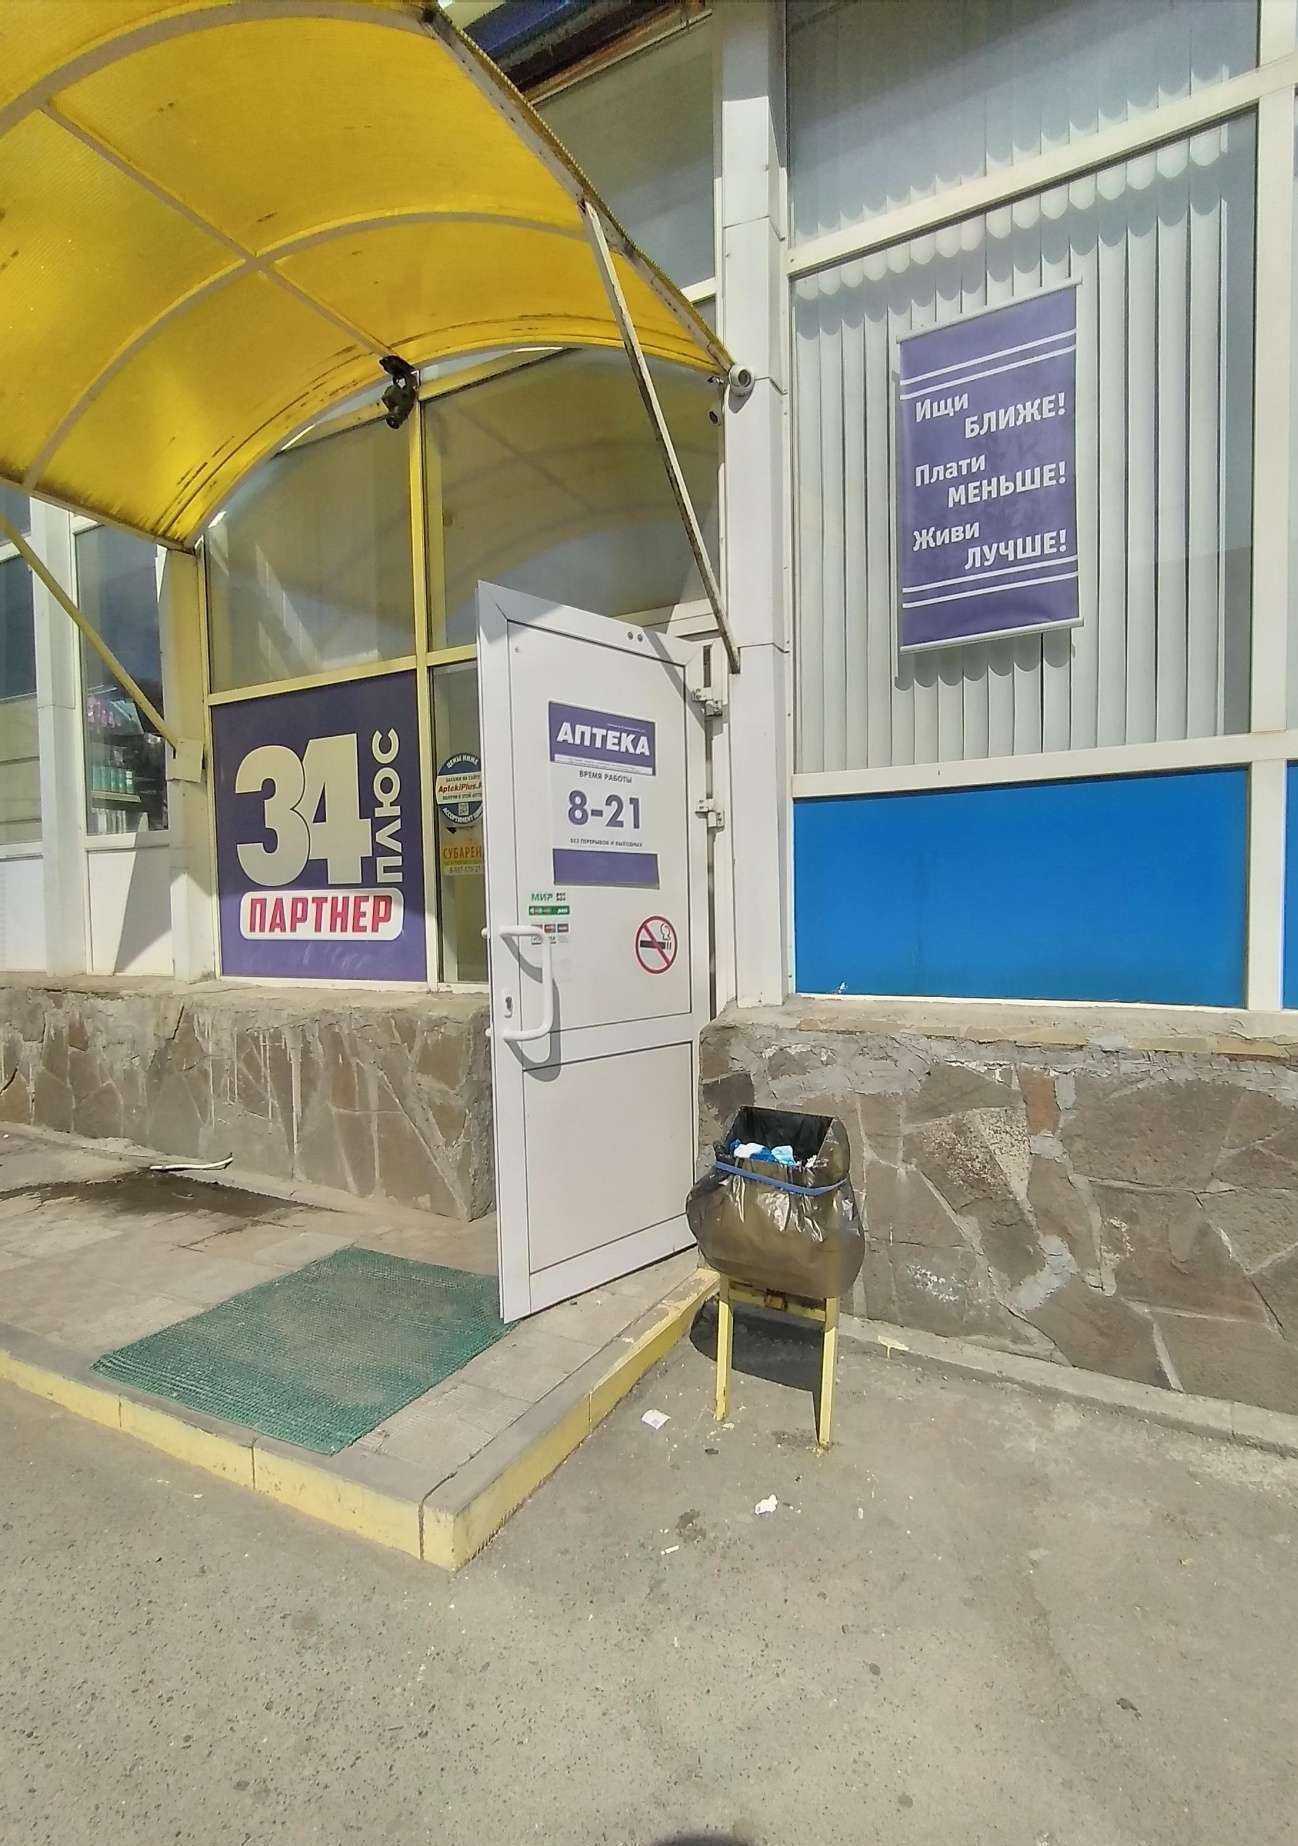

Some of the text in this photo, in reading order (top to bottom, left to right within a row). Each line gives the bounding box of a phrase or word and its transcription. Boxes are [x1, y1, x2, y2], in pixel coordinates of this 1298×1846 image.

[915, 393, 969, 422] Ищи
[965, 392, 1066, 439] БЛИЖЕ!
[915, 454, 986, 487] Плати
[948, 461, 1067, 508] МЕНЬШЕ!
[912, 522, 980, 551] Живи
[964, 529, 1067, 570] ЛУЧШЕ!
[556, 721, 651, 756] АПТЕКА
[579, 770, 633, 784] ВРЕМЯ РАБОТЫ
[235, 733, 373, 887] 34
[372, 728, 403, 884] ПЛЮС
[568, 790, 640, 829] 8-21
[250, 895, 393, 933] ПАРТНЕР
